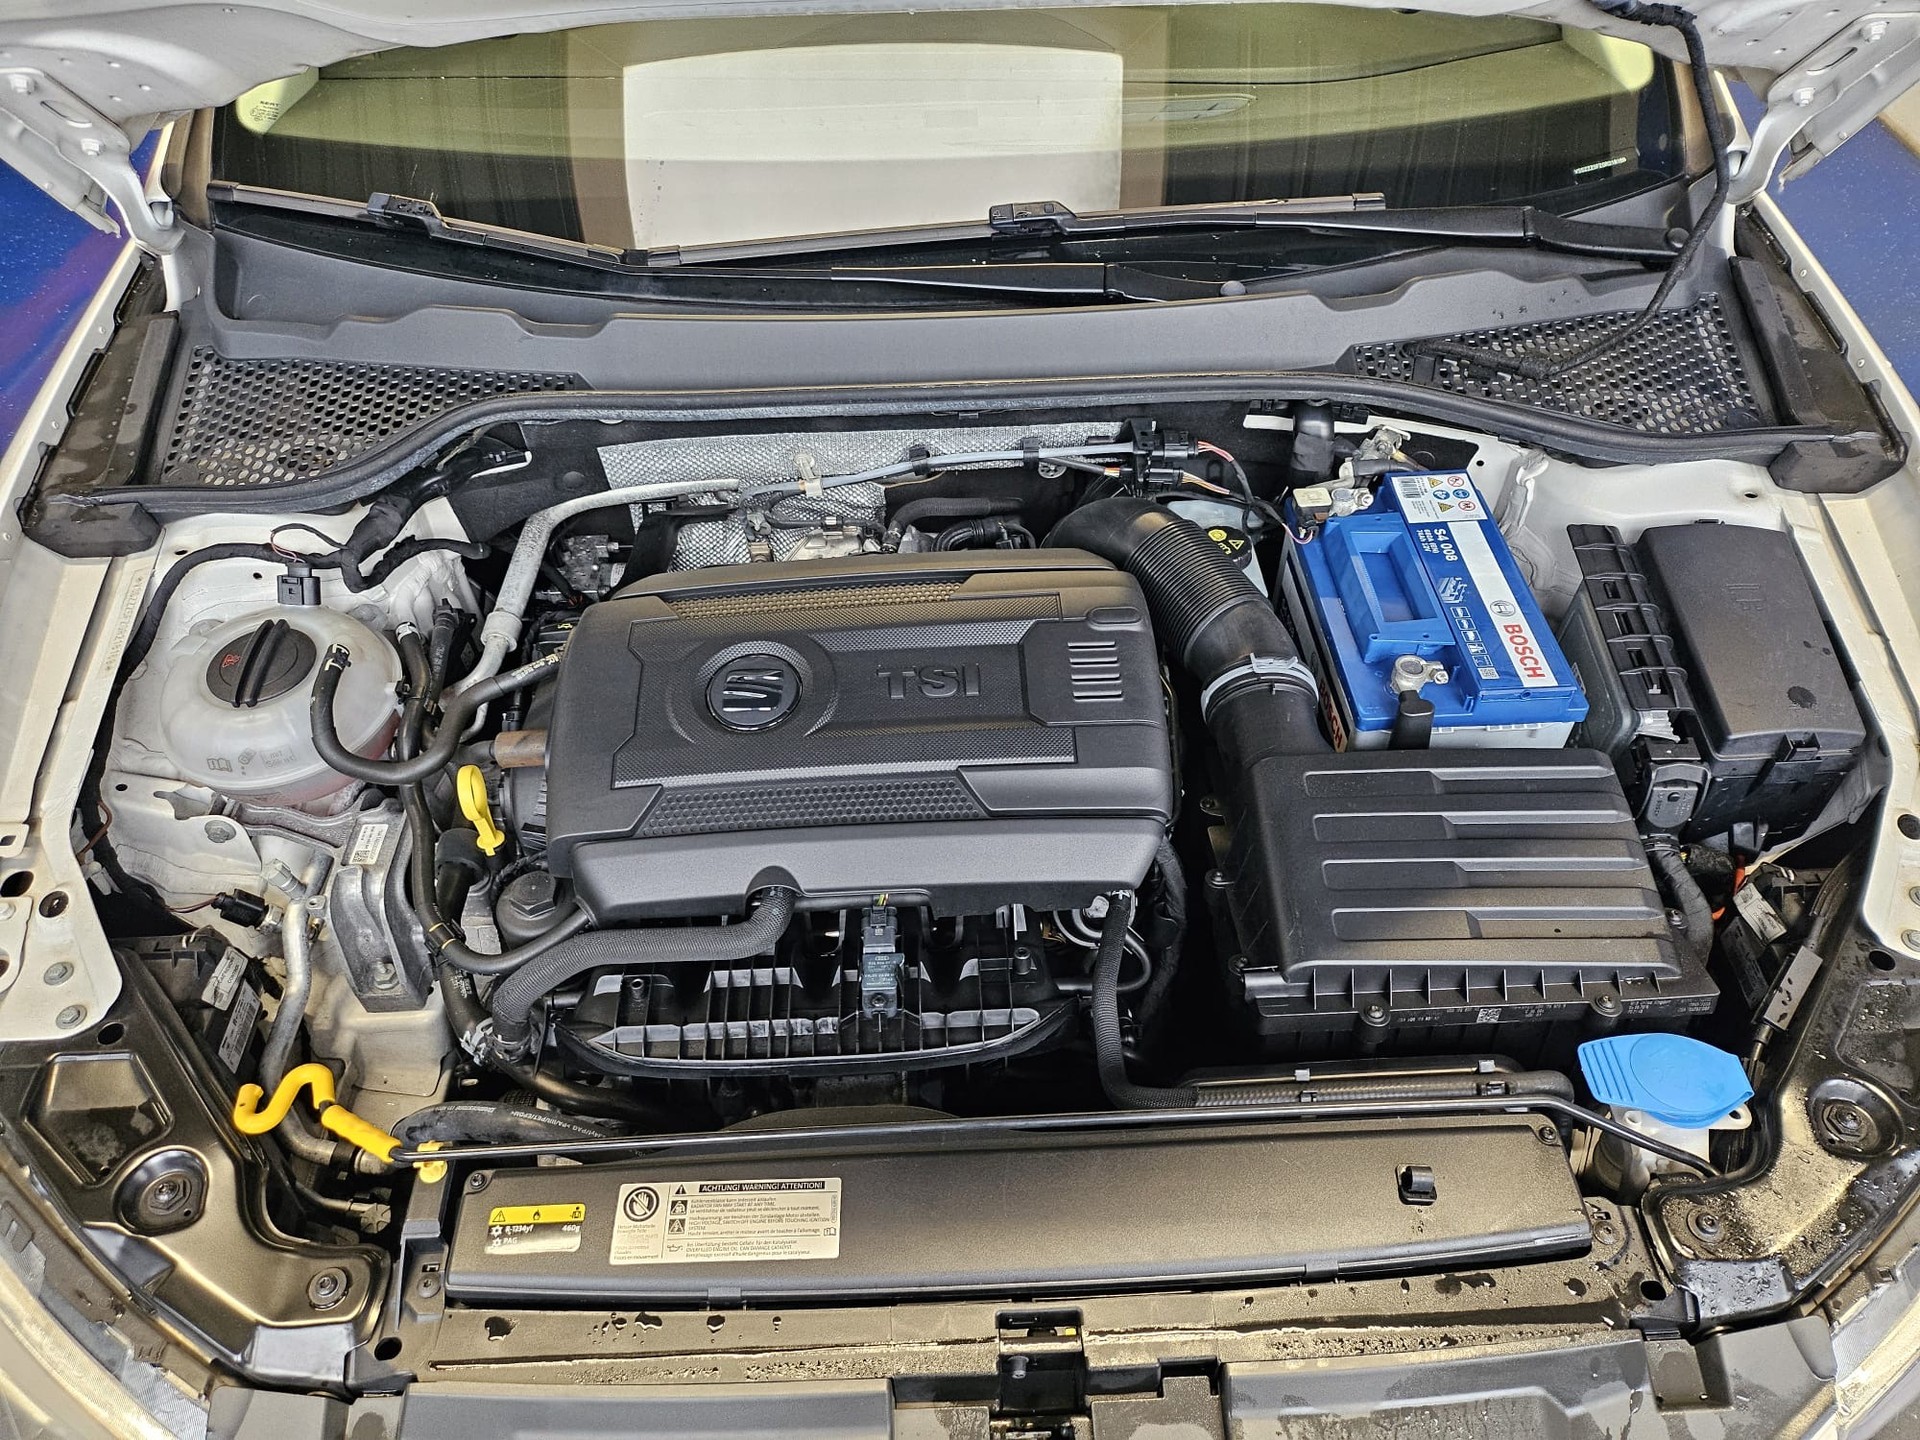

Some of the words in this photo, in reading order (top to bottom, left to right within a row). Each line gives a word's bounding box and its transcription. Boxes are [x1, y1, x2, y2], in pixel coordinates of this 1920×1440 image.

[1433, 528, 1450, 542] S4
[1440, 542, 1459, 562] 008
[1503, 624, 1546, 678] BOSCH
[876, 663, 981, 700] TSI
[702, 1184, 740, 1192] ACHTUNG!
[741, 1183, 780, 1191] WARNING!
[781, 1182, 823, 1190] ATTENTION!
[561, 1224, 581, 1232] 460g
[503, 1237, 518, 1245] PAG
